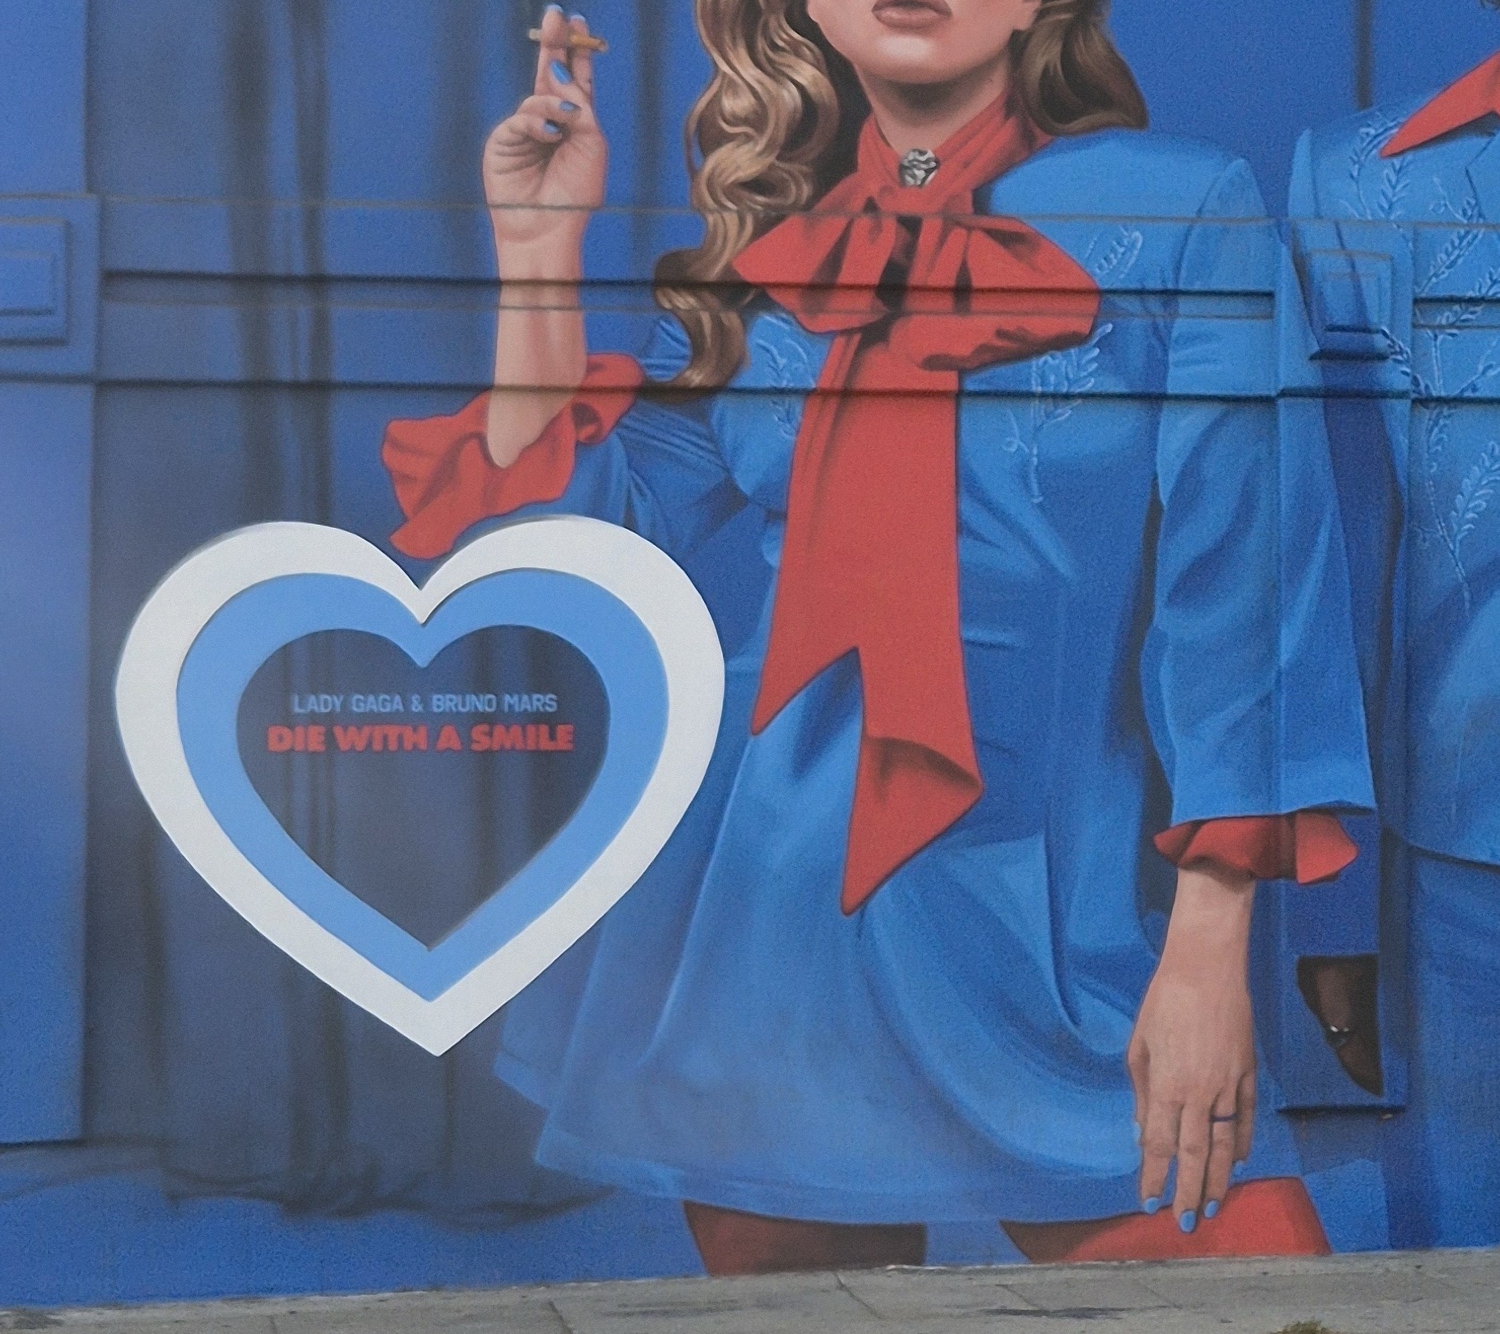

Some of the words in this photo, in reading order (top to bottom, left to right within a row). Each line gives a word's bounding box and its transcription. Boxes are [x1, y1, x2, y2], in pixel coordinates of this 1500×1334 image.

[293, 693, 343, 713] LADY
[351, 693, 404, 713] GAGA
[411, 693, 424, 713] &
[431, 693, 497, 713] BRUNO
[504, 693, 558, 713] MARS
[266, 724, 326, 752] DIE
[332, 724, 429, 752] WITH
[435, 724, 462, 752] A
[470, 723, 574, 752] SMILE
